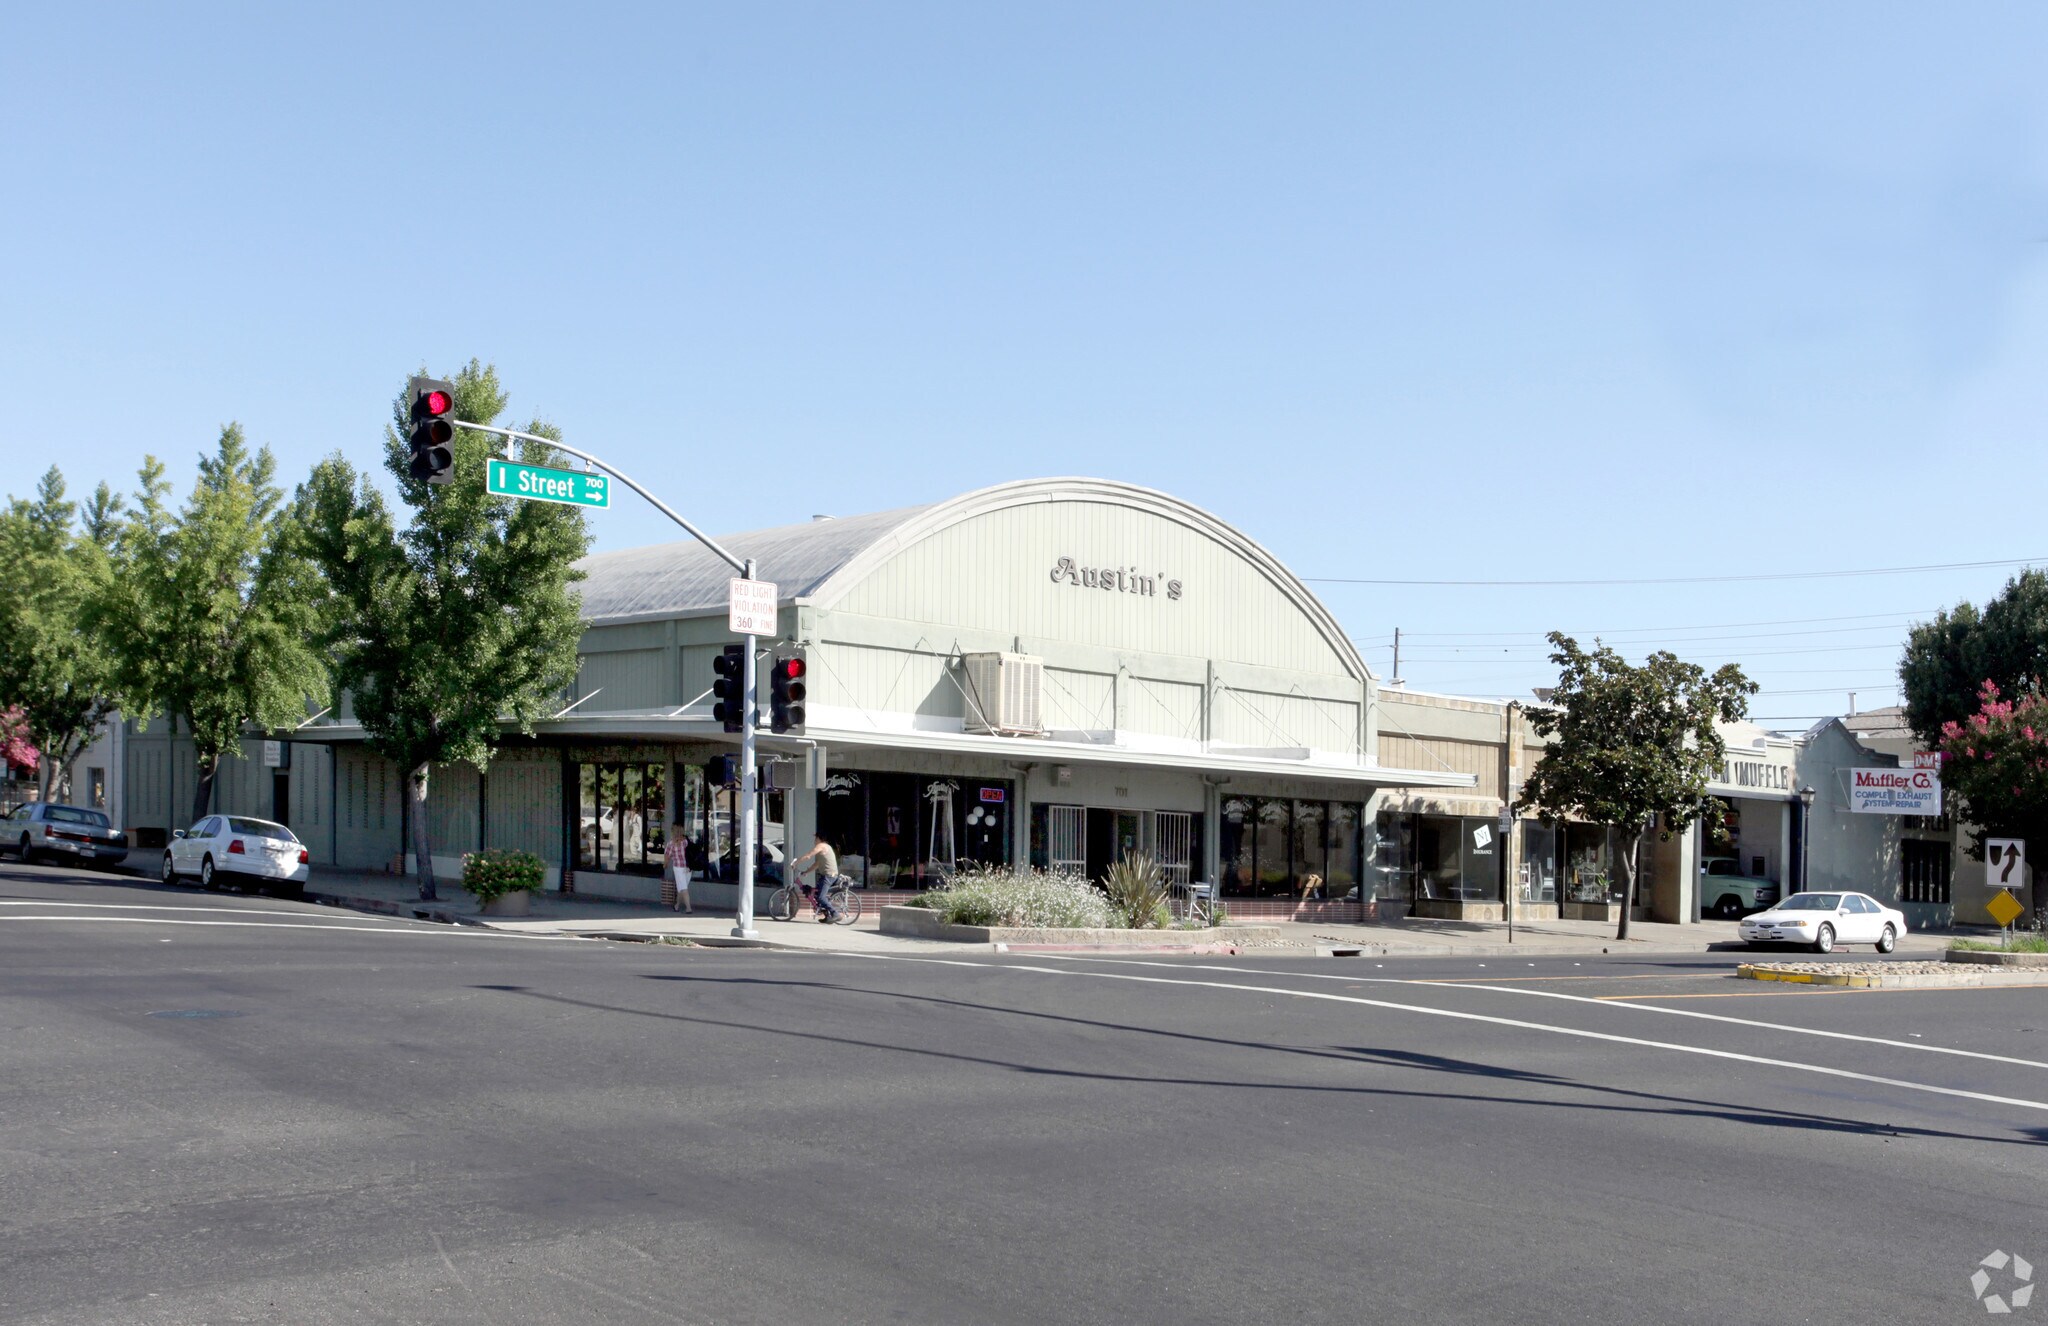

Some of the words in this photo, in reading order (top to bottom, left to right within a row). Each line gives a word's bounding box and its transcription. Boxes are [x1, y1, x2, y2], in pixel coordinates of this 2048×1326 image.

[500, 467, 505, 488] I
[518, 470, 574, 498] Street
[585, 477, 604, 489] 700
[1050, 556, 1183, 600] Austin's
[734, 583, 749, 596] RED
[752, 585, 773, 599] LIGHT
[734, 599, 774, 616] VIOLATION
[760, 619, 774, 631] FINE
[1855, 772, 1910, 787] Muffler
[1912, 773, 1933, 789] Co.
[981, 790, 1003, 801] OPEN
[1896, 792, 1932, 801] EXHAUST
[1864, 799, 1892, 808] SYSTEM
[1895, 800, 1922, 809] REPAIR
